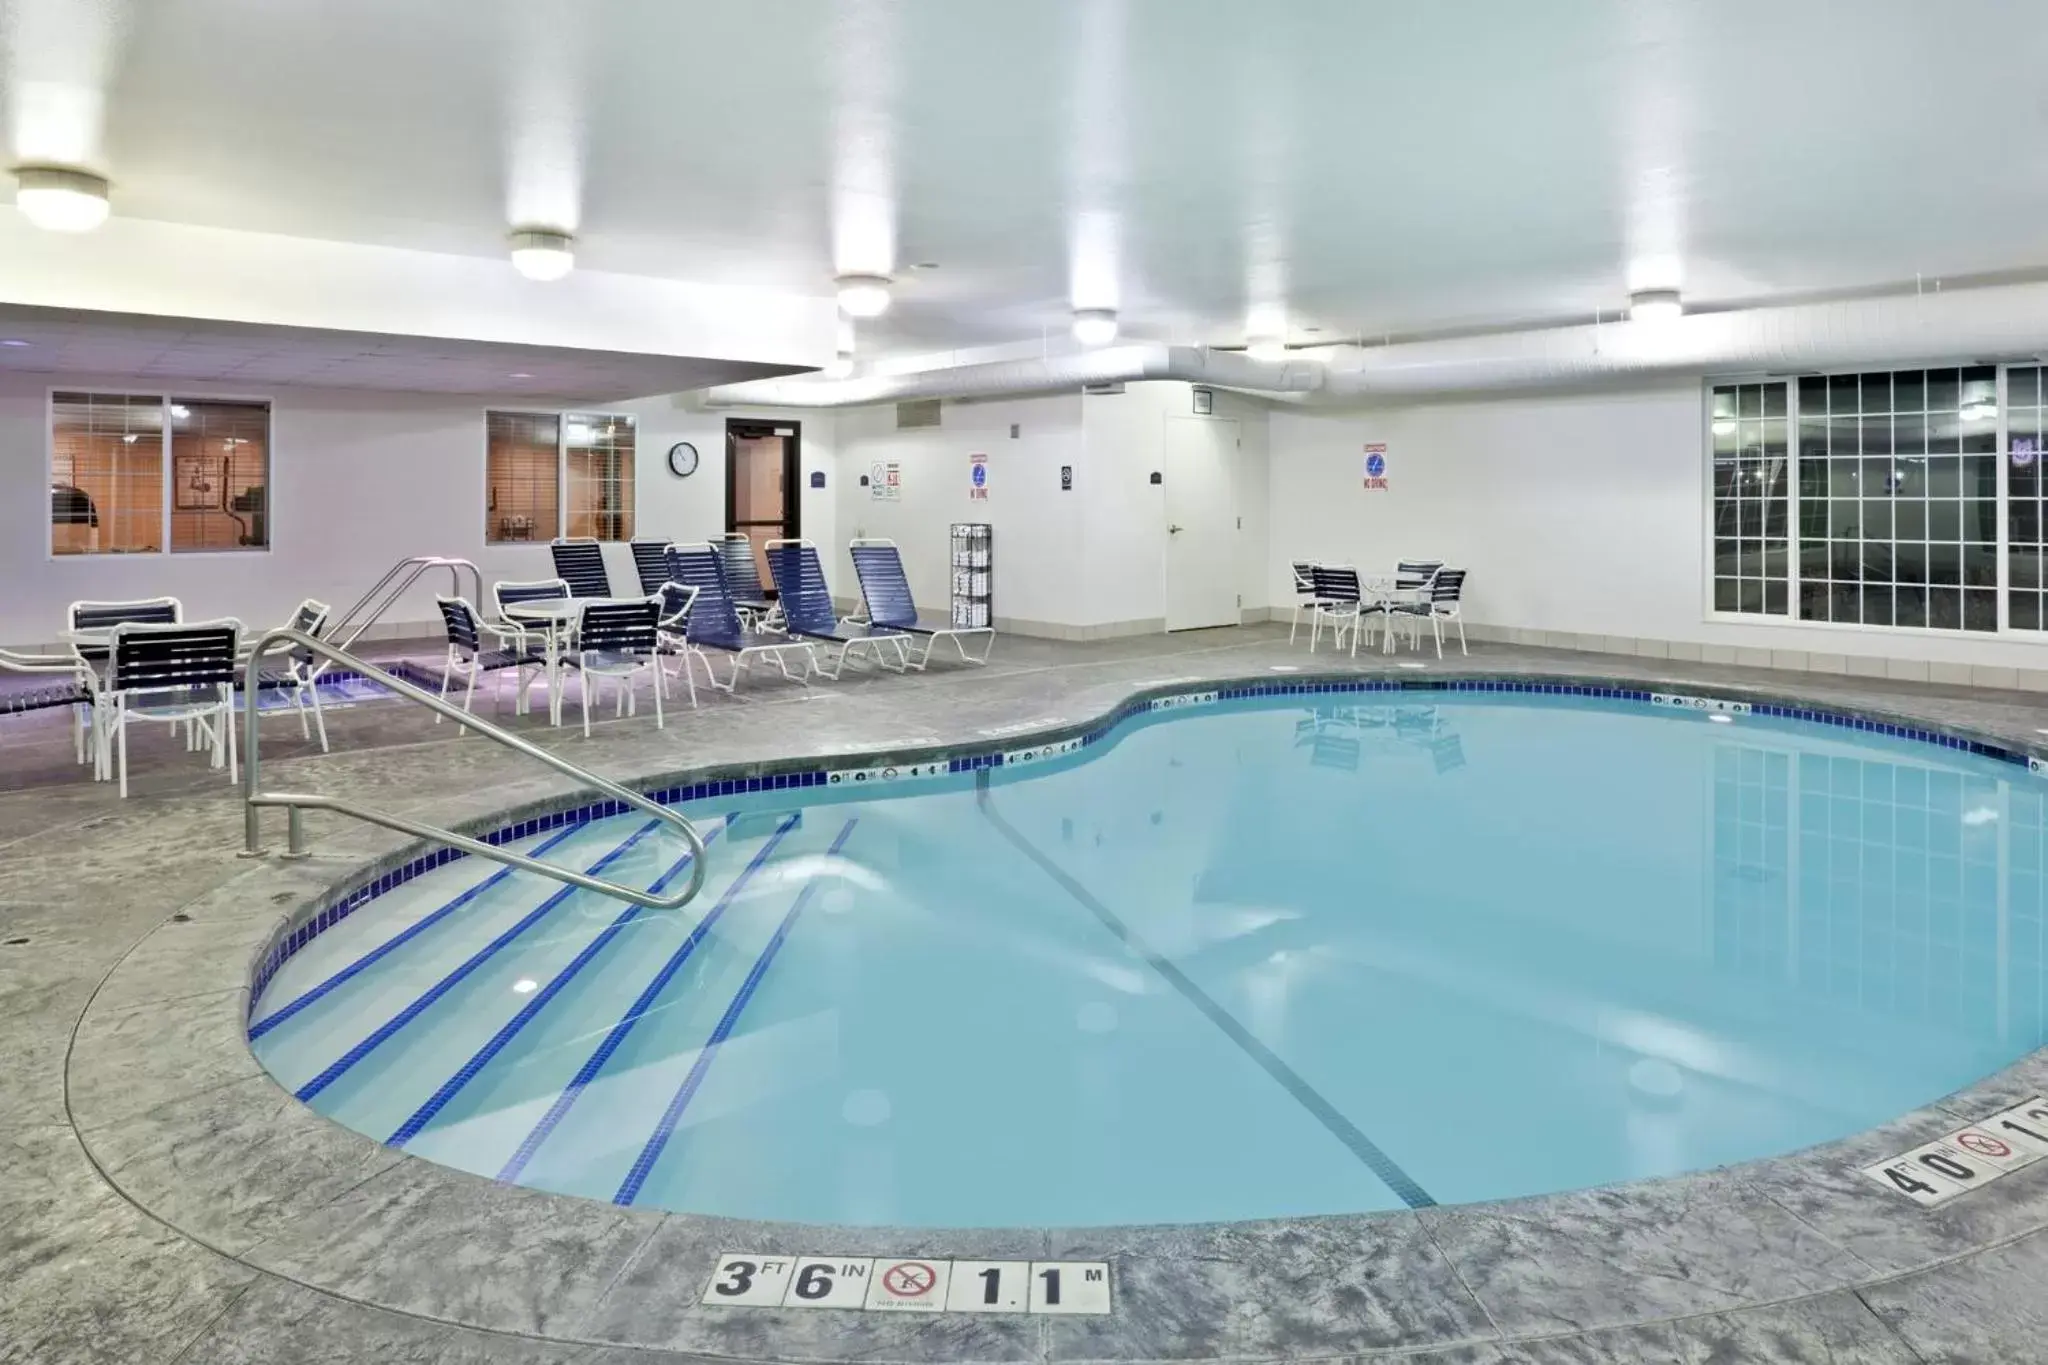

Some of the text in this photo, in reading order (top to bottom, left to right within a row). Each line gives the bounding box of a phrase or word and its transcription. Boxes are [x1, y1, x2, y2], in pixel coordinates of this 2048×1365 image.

[1883, 1167, 1938, 1195] 4
[715, 1261, 866, 1300] 3 FT 6 IN
[1085, 1269, 1103, 1281] M
